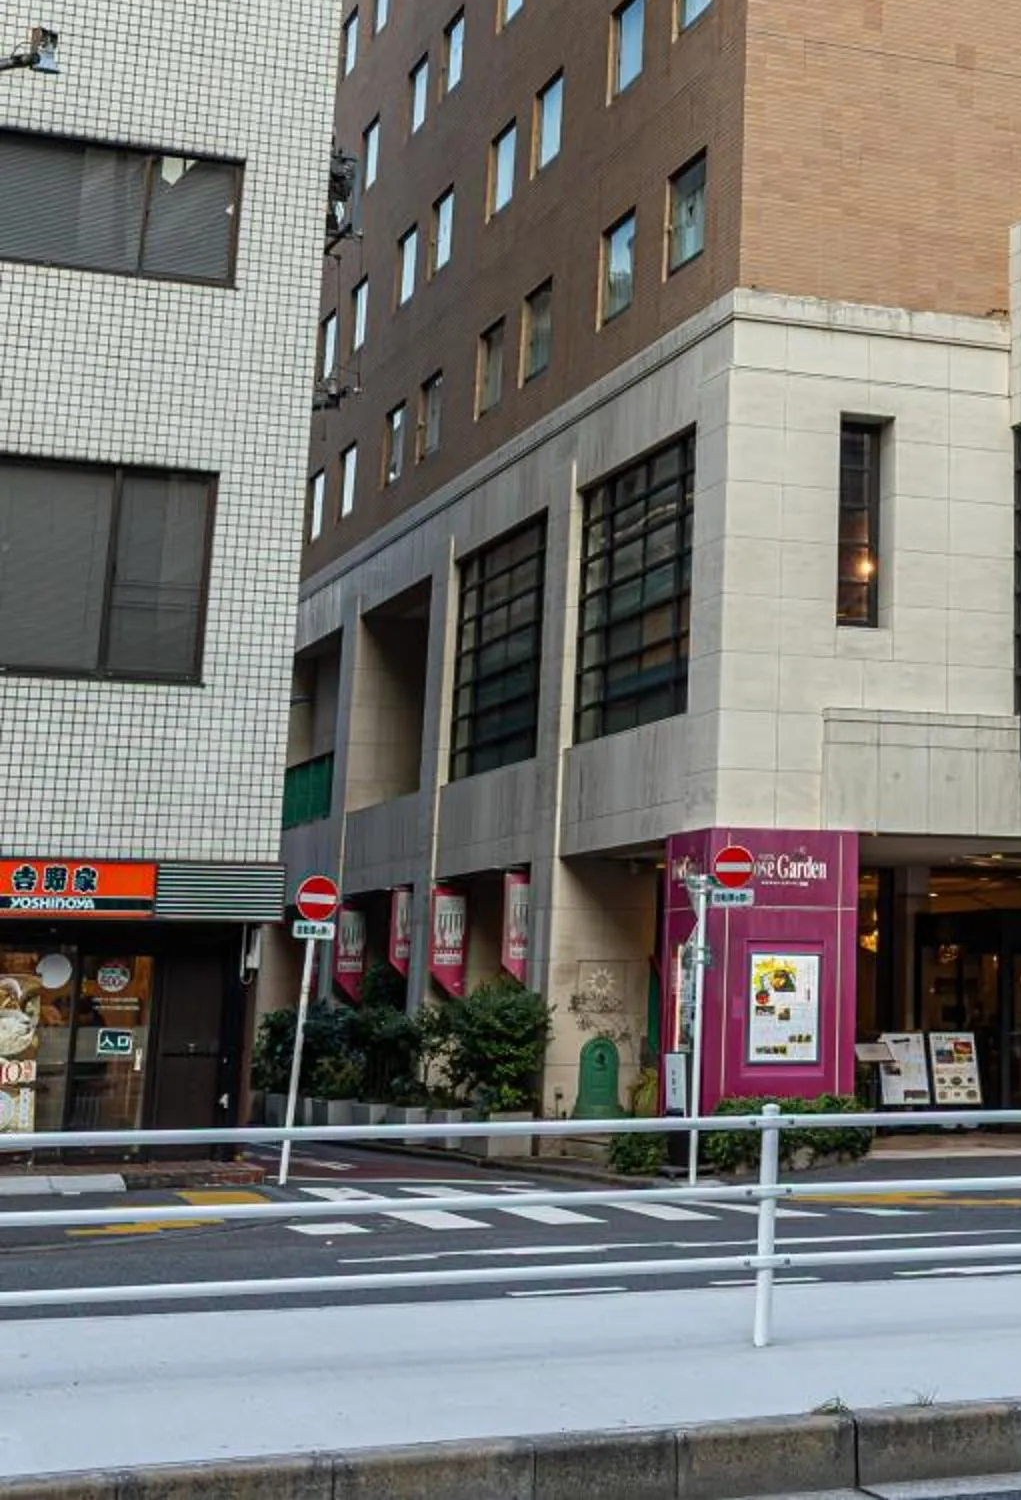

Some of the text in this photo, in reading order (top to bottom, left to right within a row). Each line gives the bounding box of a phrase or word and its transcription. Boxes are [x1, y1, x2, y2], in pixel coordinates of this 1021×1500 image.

[12, 864, 98, 893] 吉野家
[777, 853, 828, 879] Garden
[101, 1035, 129, 1047] 入口
